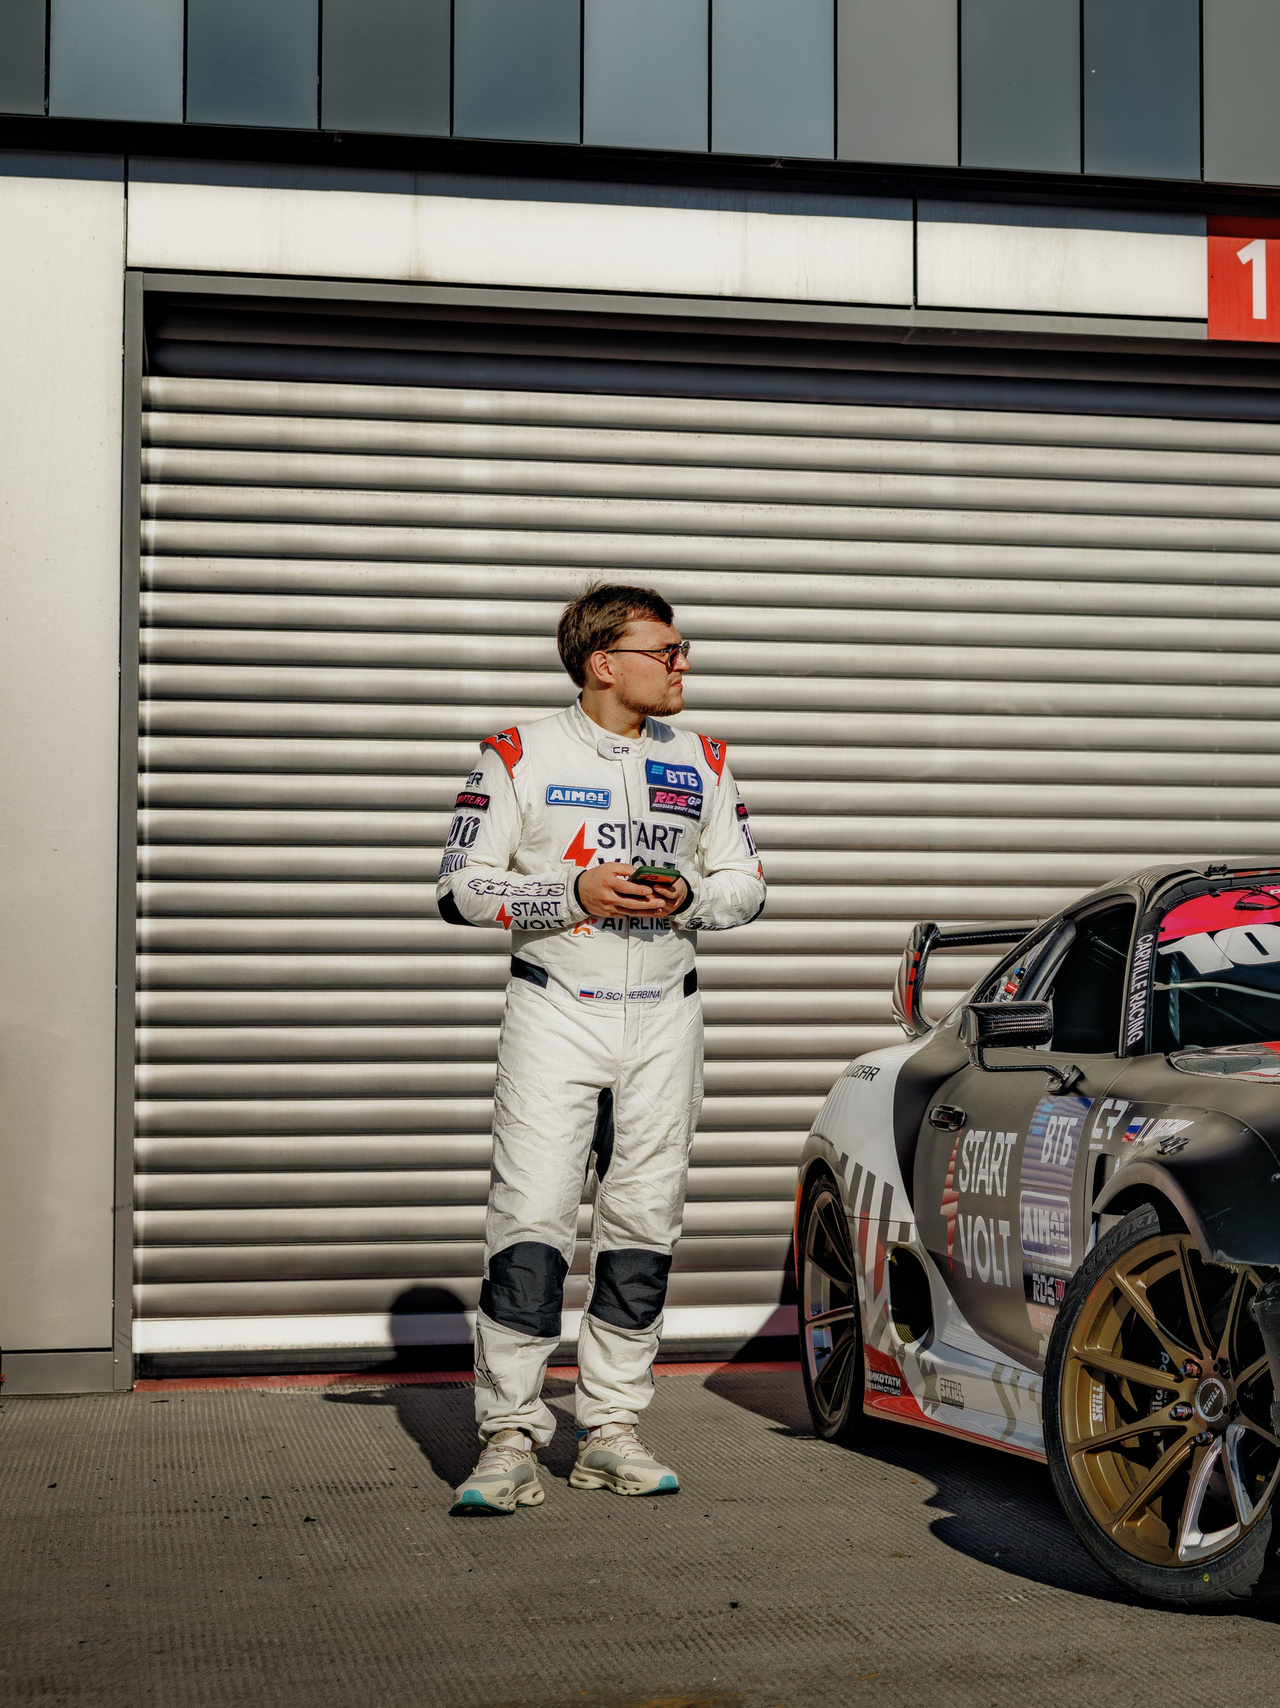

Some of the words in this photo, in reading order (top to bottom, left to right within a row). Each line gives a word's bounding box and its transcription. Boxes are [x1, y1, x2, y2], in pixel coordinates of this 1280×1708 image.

[612, 746, 630, 754] CR
[666, 769, 699, 787] ВТБ
[549, 789, 608, 804] AIMOL
[654, 791, 690, 807] RDS
[597, 820, 684, 854] START
[511, 902, 561, 917] START
[515, 919, 567, 930] VOLT
[600, 917, 671, 931] AIRLINE
[1131, 933, 1154, 993] CARVILLE
[1126, 989, 1147, 1047] RACING
[1040, 1115, 1079, 1166] ВТБ
[959, 1129, 1018, 1198] START
[1023, 1206, 1069, 1250] AIMOL
[958, 1213, 1012, 1288] VOLT
[1092, 1384, 1104, 1422] SKILL
[1203, 1387, 1221, 1414] SKILL
